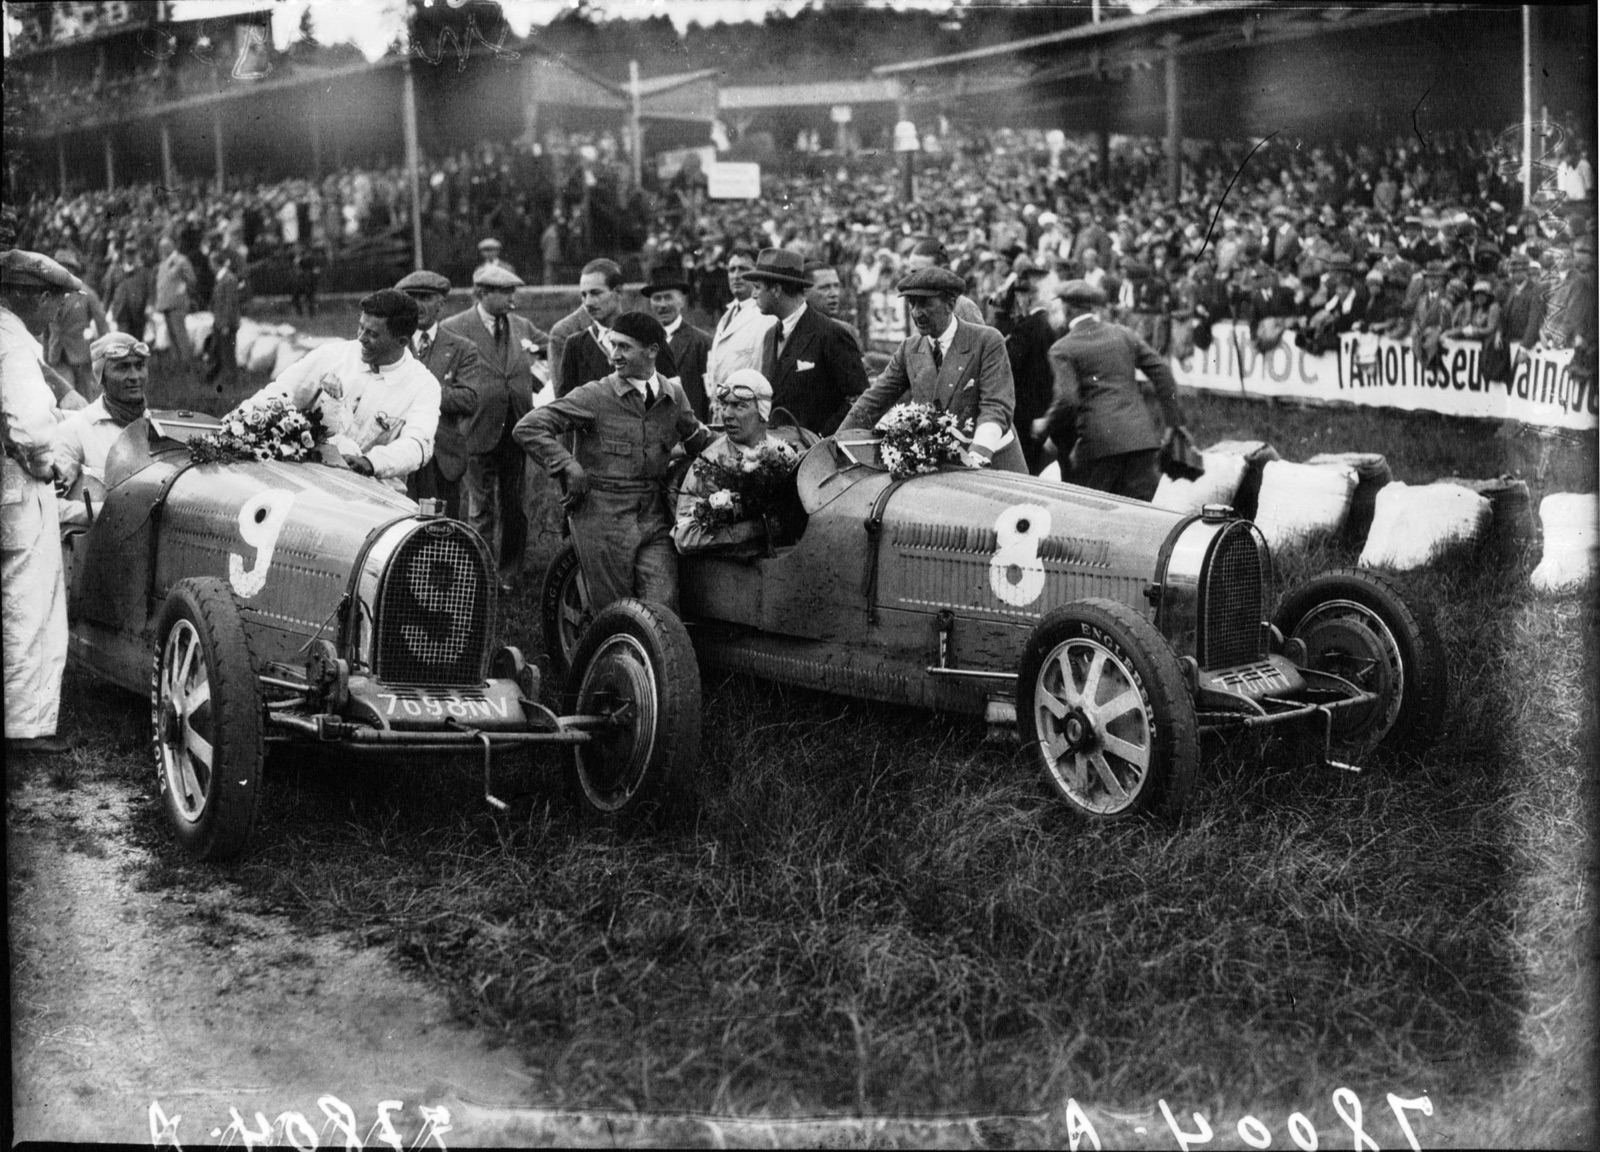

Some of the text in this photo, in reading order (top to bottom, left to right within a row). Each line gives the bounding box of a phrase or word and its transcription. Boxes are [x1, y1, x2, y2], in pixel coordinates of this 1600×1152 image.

[229, 488, 295, 598] 9
[989, 503, 1051, 607] 8
[401, 539, 477, 665] 9
[151, 639, 167, 795] ENGLEBERT
[1081, 622, 1157, 738] ENGLEBERT
